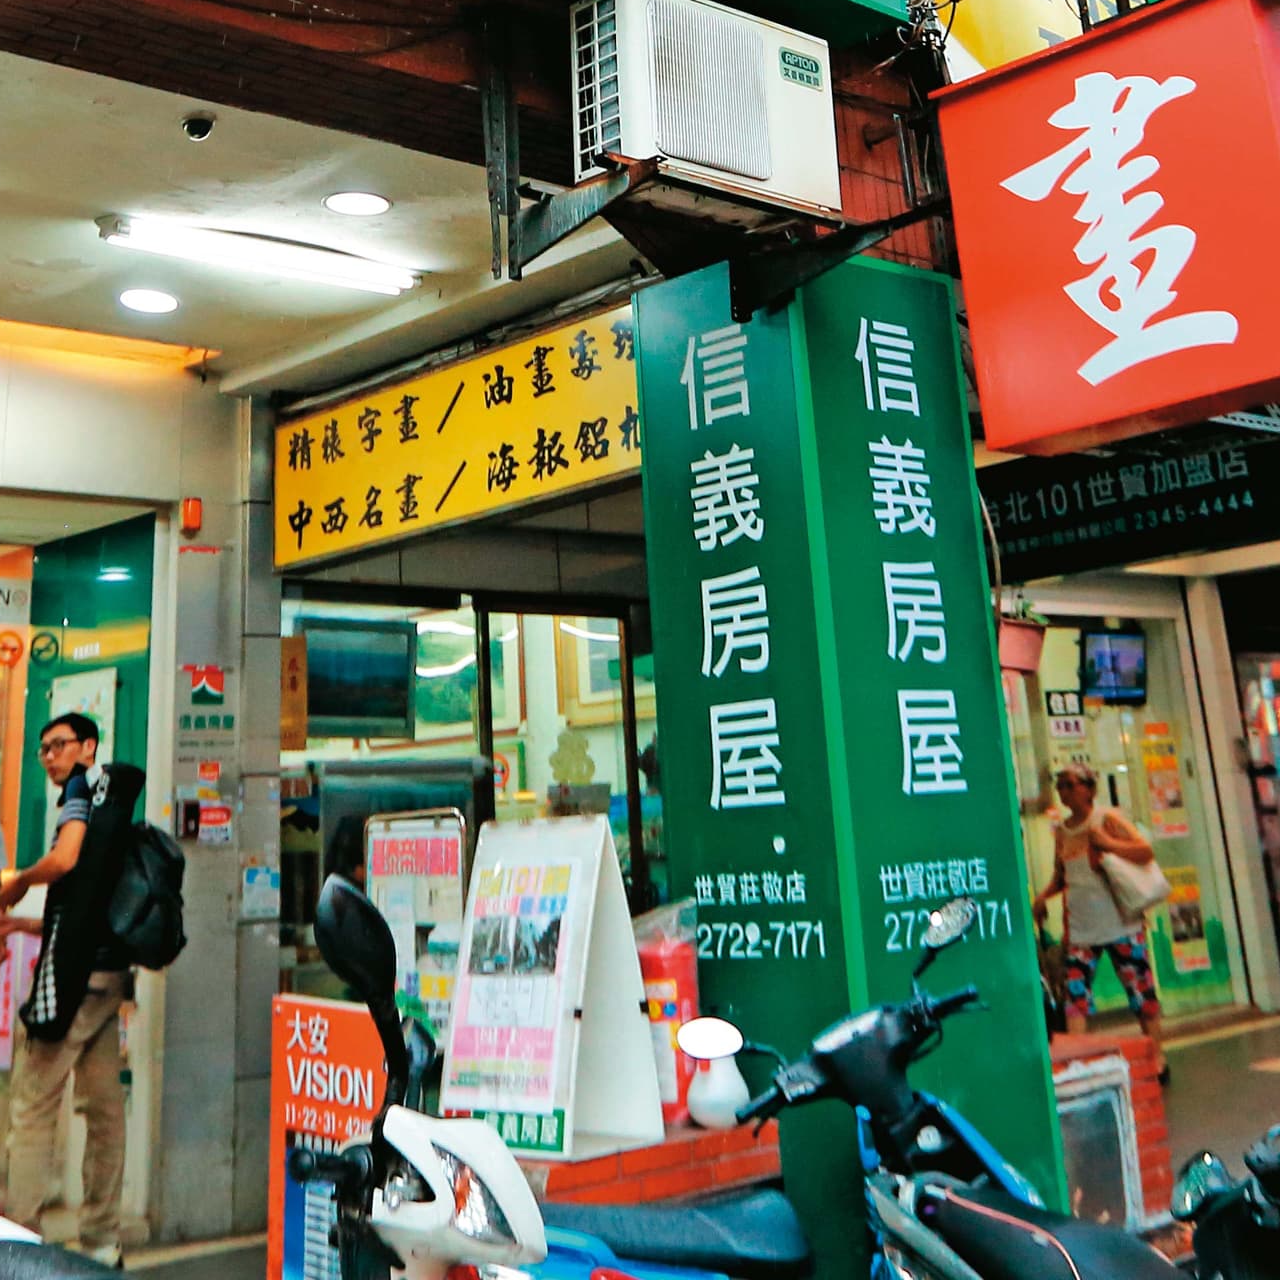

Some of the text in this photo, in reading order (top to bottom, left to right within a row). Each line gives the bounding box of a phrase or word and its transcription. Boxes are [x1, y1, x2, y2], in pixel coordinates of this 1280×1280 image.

[999, 72, 1239, 387] 畫
[1134, 489, 1255, 532] 2345-4444
[679, 322, 786, 811] 信義房屋
[855, 316, 968, 796] 信義房屋
[694, 870, 807, 906] 世貿莊敬店
[879, 857, 990, 904] 世貿莊敬店
[286, 1009, 329, 1056] 大安
[286, 1055, 374, 1110] VISION
